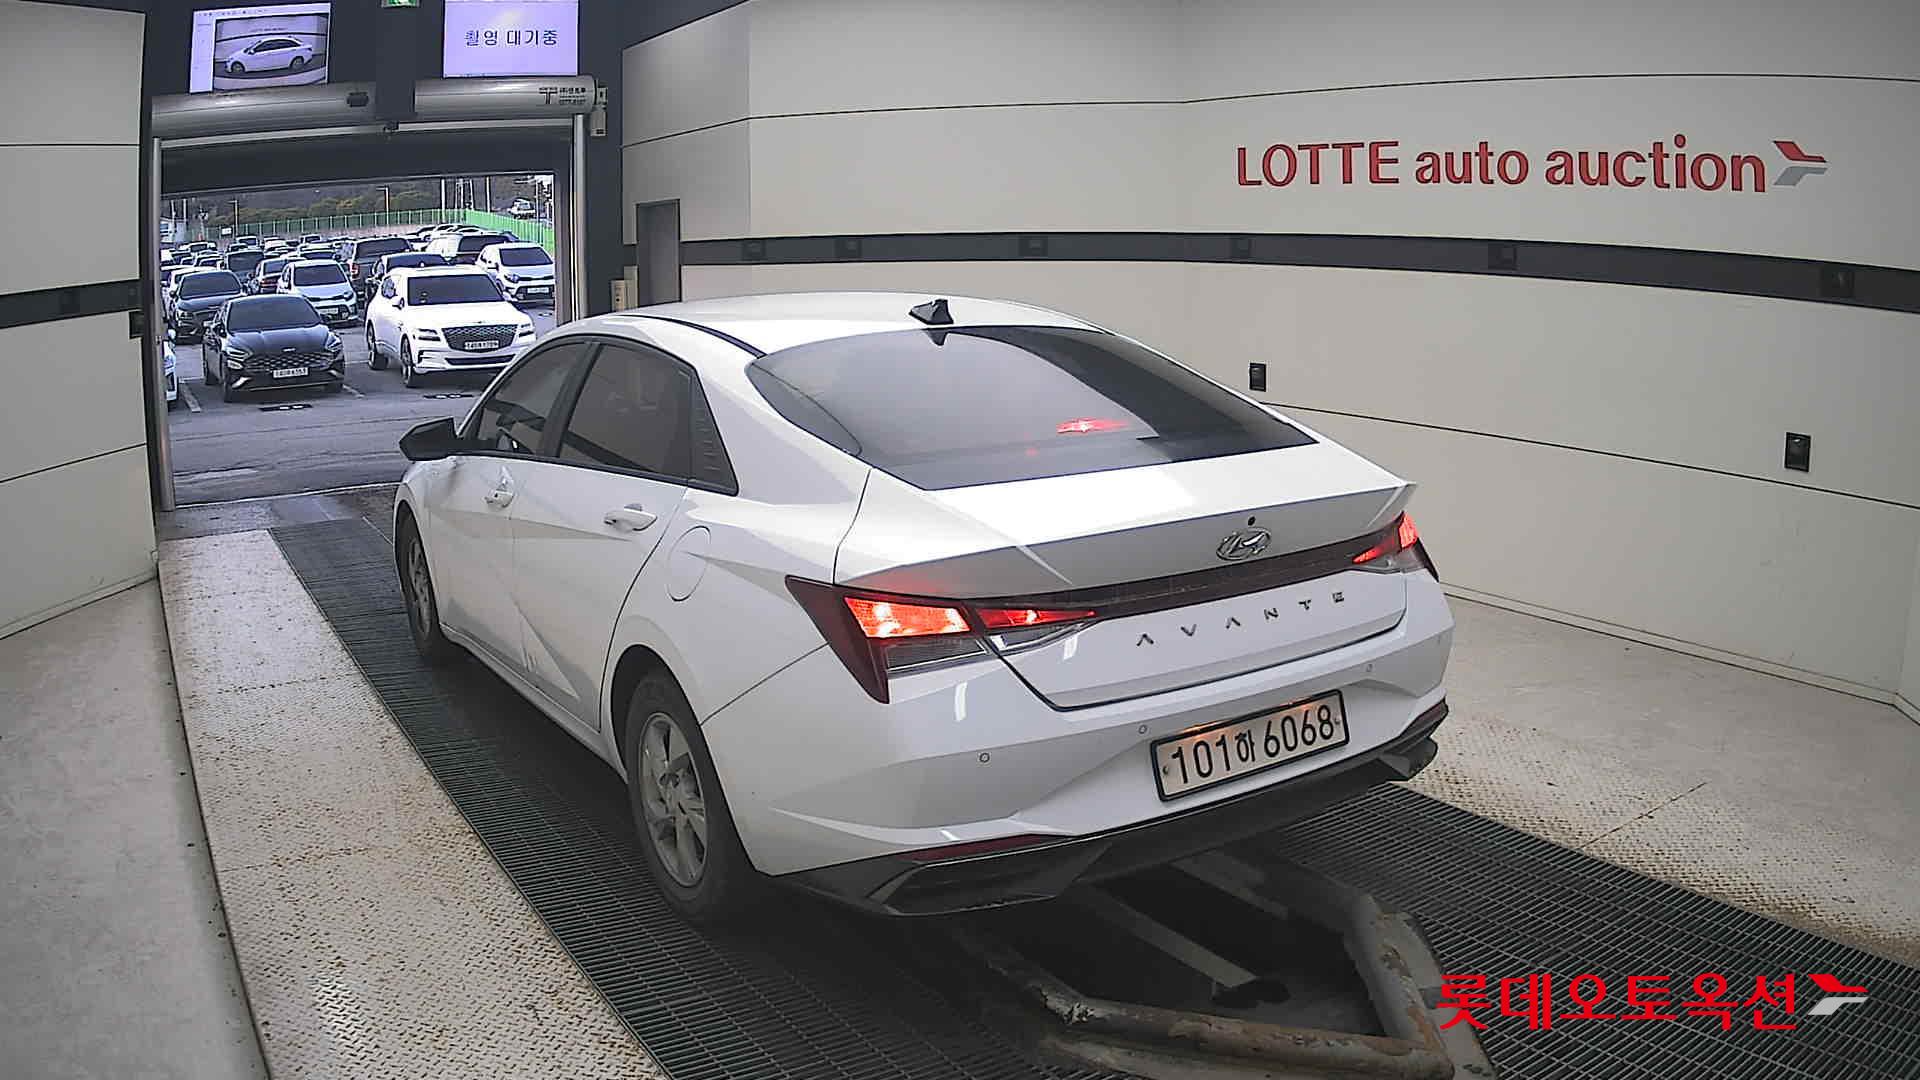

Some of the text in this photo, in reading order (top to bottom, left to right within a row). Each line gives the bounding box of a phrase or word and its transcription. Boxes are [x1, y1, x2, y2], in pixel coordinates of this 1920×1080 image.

[506, 30, 559, 46] 대기중
[1236, 133, 1766, 193] LOTTE auto auction
[1136, 591, 1345, 647] AVANTE
